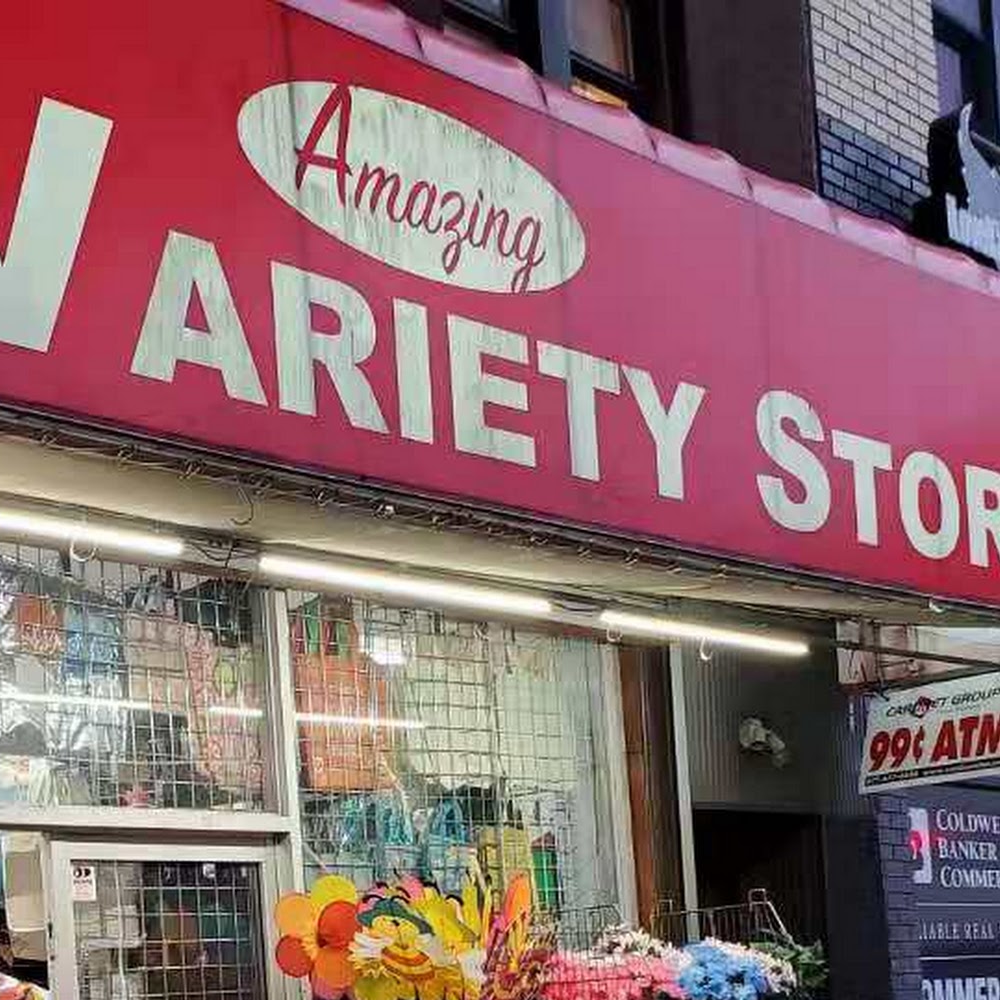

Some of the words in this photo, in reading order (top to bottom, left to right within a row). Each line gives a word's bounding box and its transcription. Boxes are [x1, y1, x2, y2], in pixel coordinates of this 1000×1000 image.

[295, 80, 546, 293] Amazing
[755, 389, 1000, 568] STOR
[930, 713, 1000, 762] ATM
[937, 837, 998, 861] BANKER
